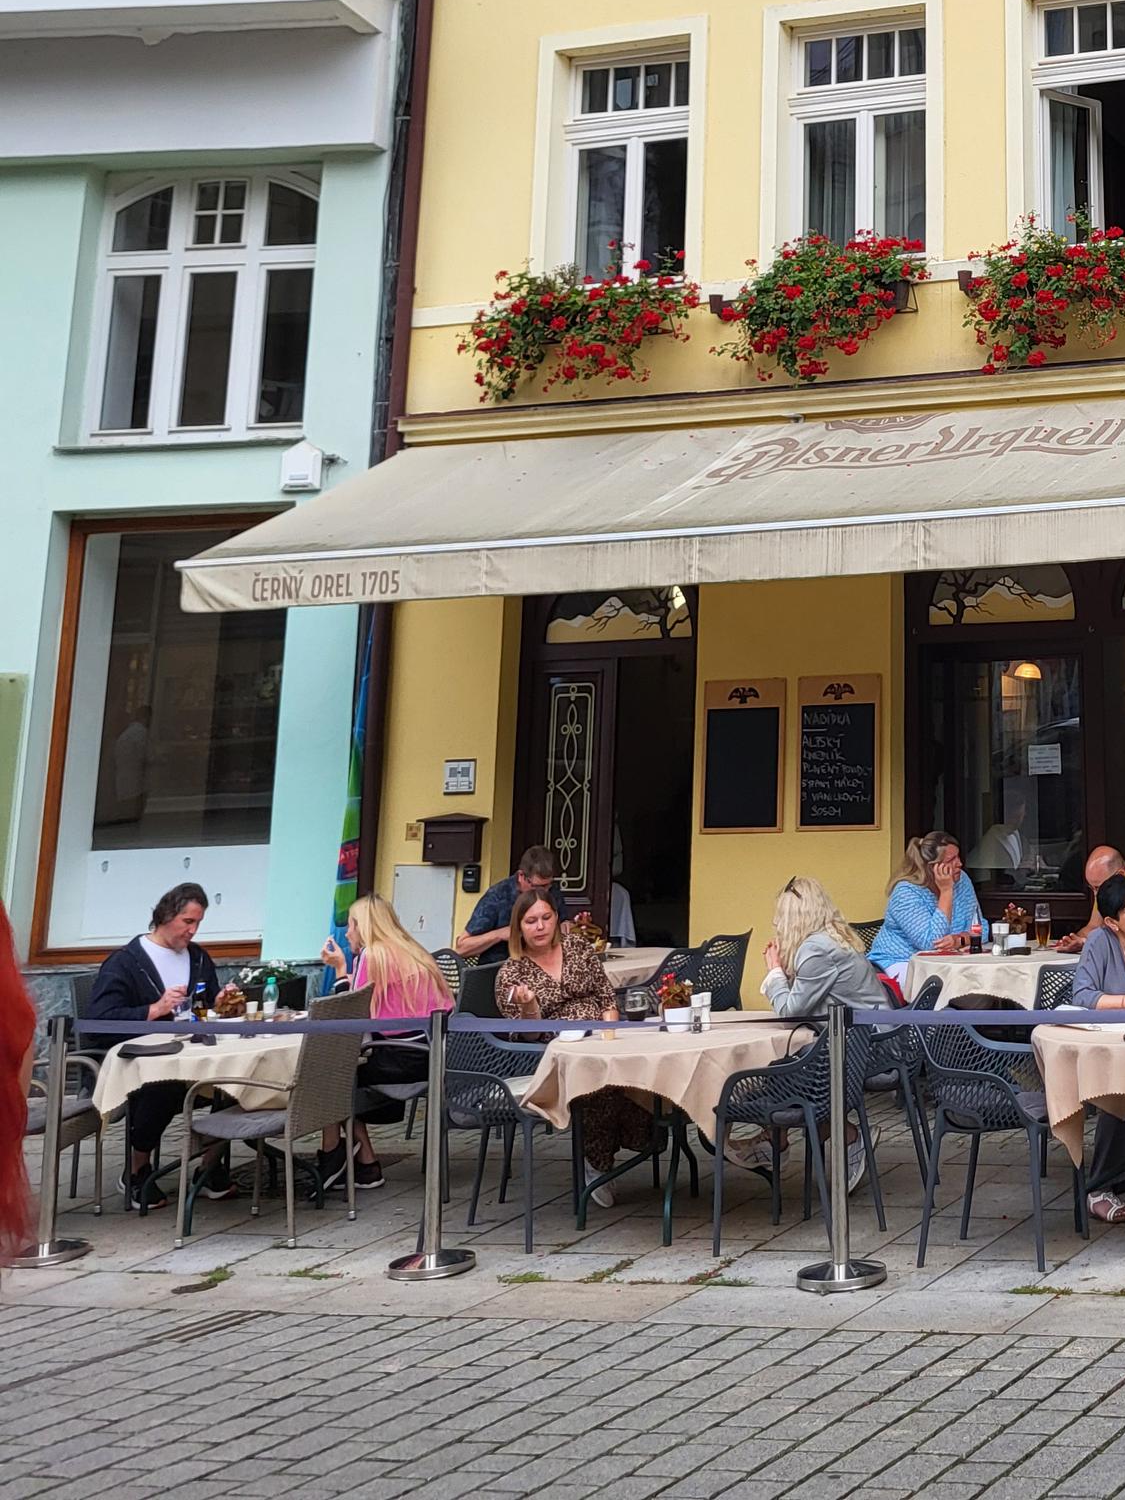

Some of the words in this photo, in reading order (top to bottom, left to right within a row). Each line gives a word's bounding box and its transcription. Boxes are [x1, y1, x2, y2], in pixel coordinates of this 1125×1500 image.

[693, 436, 938, 489] Pilsner
[252, 569, 304, 602] ČERNÝ
[310, 573, 353, 599] OREL
[361, 570, 400, 596] 1705
